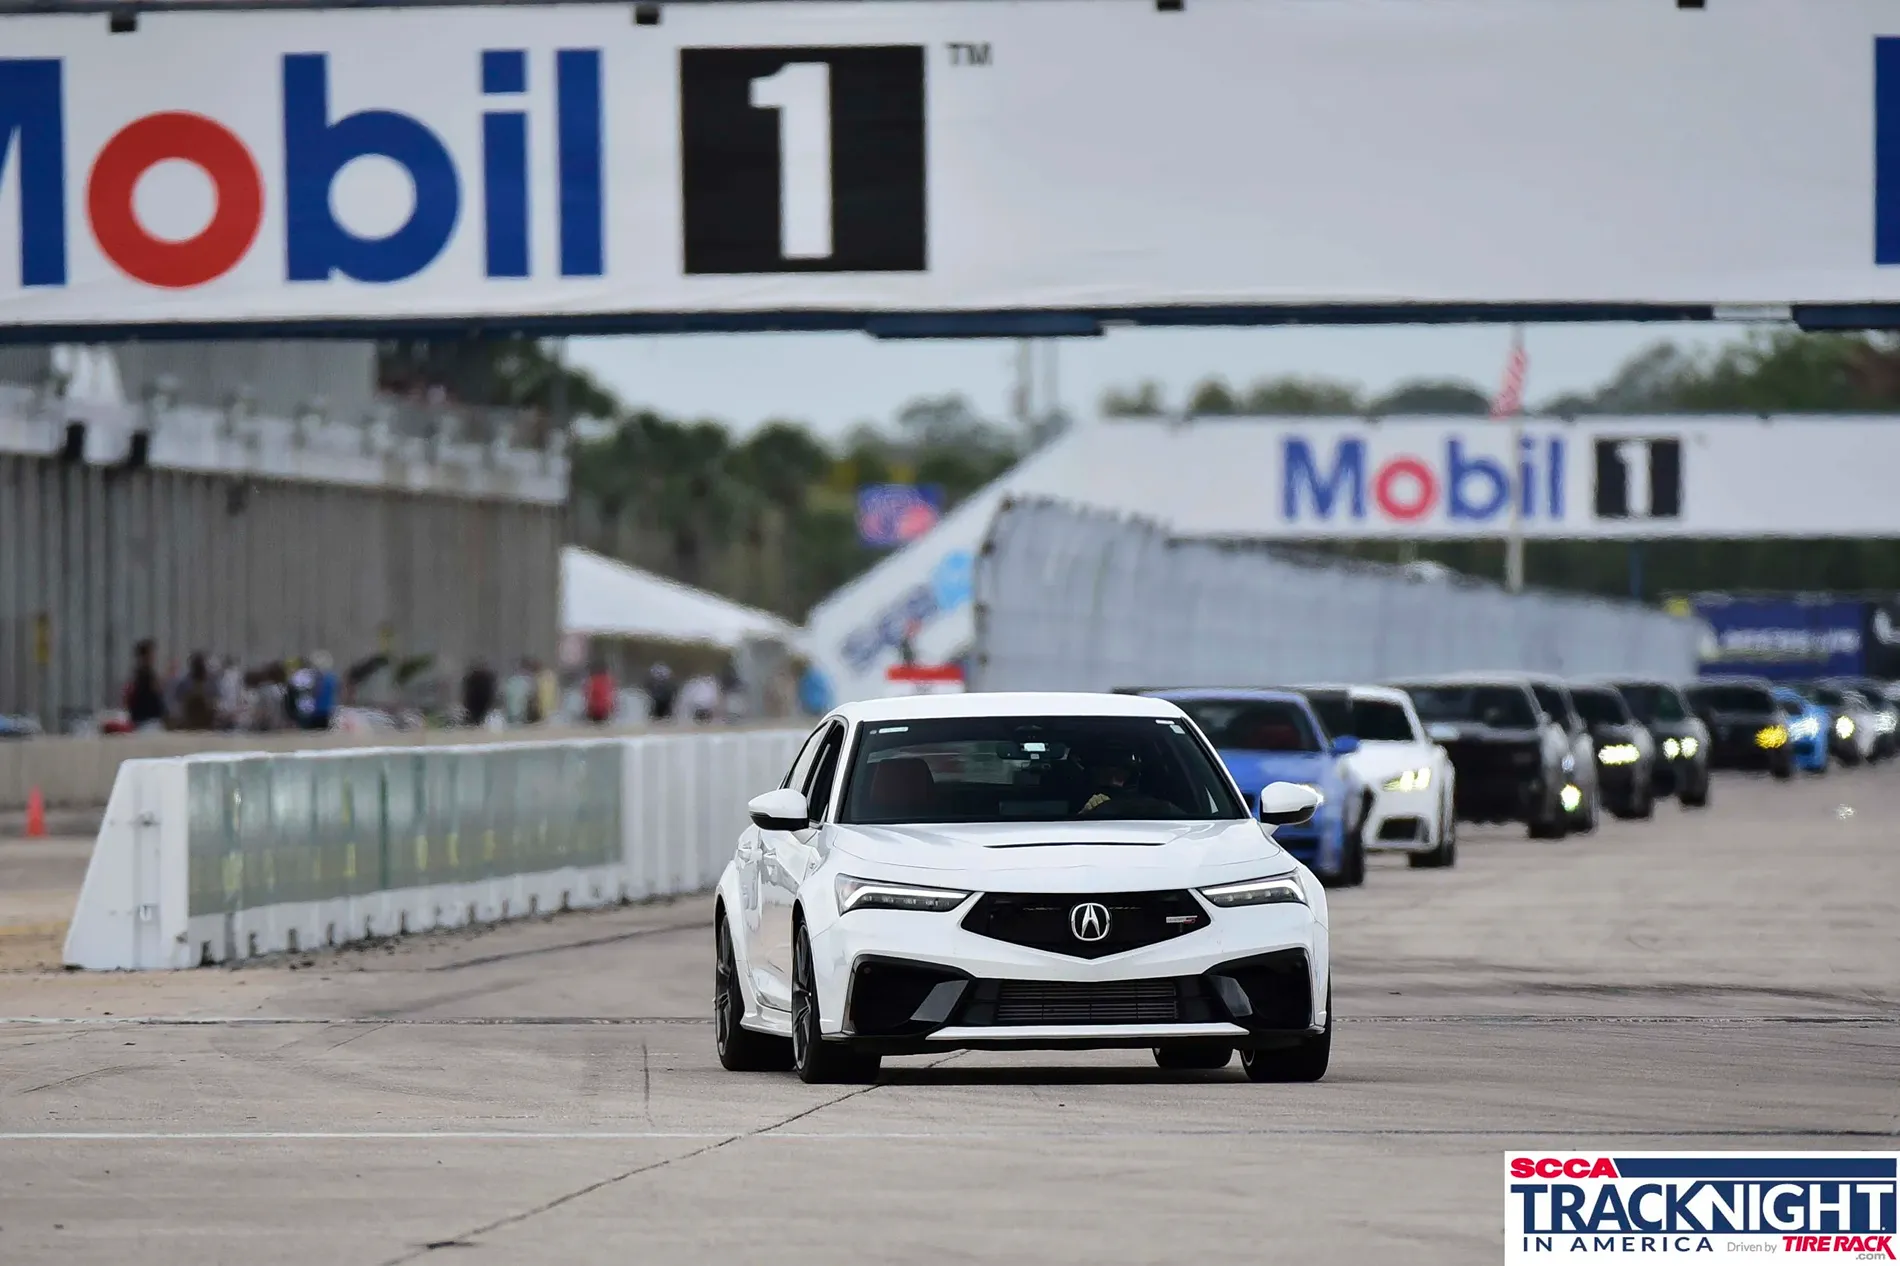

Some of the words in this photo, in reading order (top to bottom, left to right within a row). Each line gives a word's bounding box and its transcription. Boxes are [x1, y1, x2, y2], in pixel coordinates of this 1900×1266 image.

[750, 61, 833, 260] 1
[947, 42, 993, 67] TM
[1281, 434, 1565, 521] Mobil
[1613, 440, 1655, 516] 1
